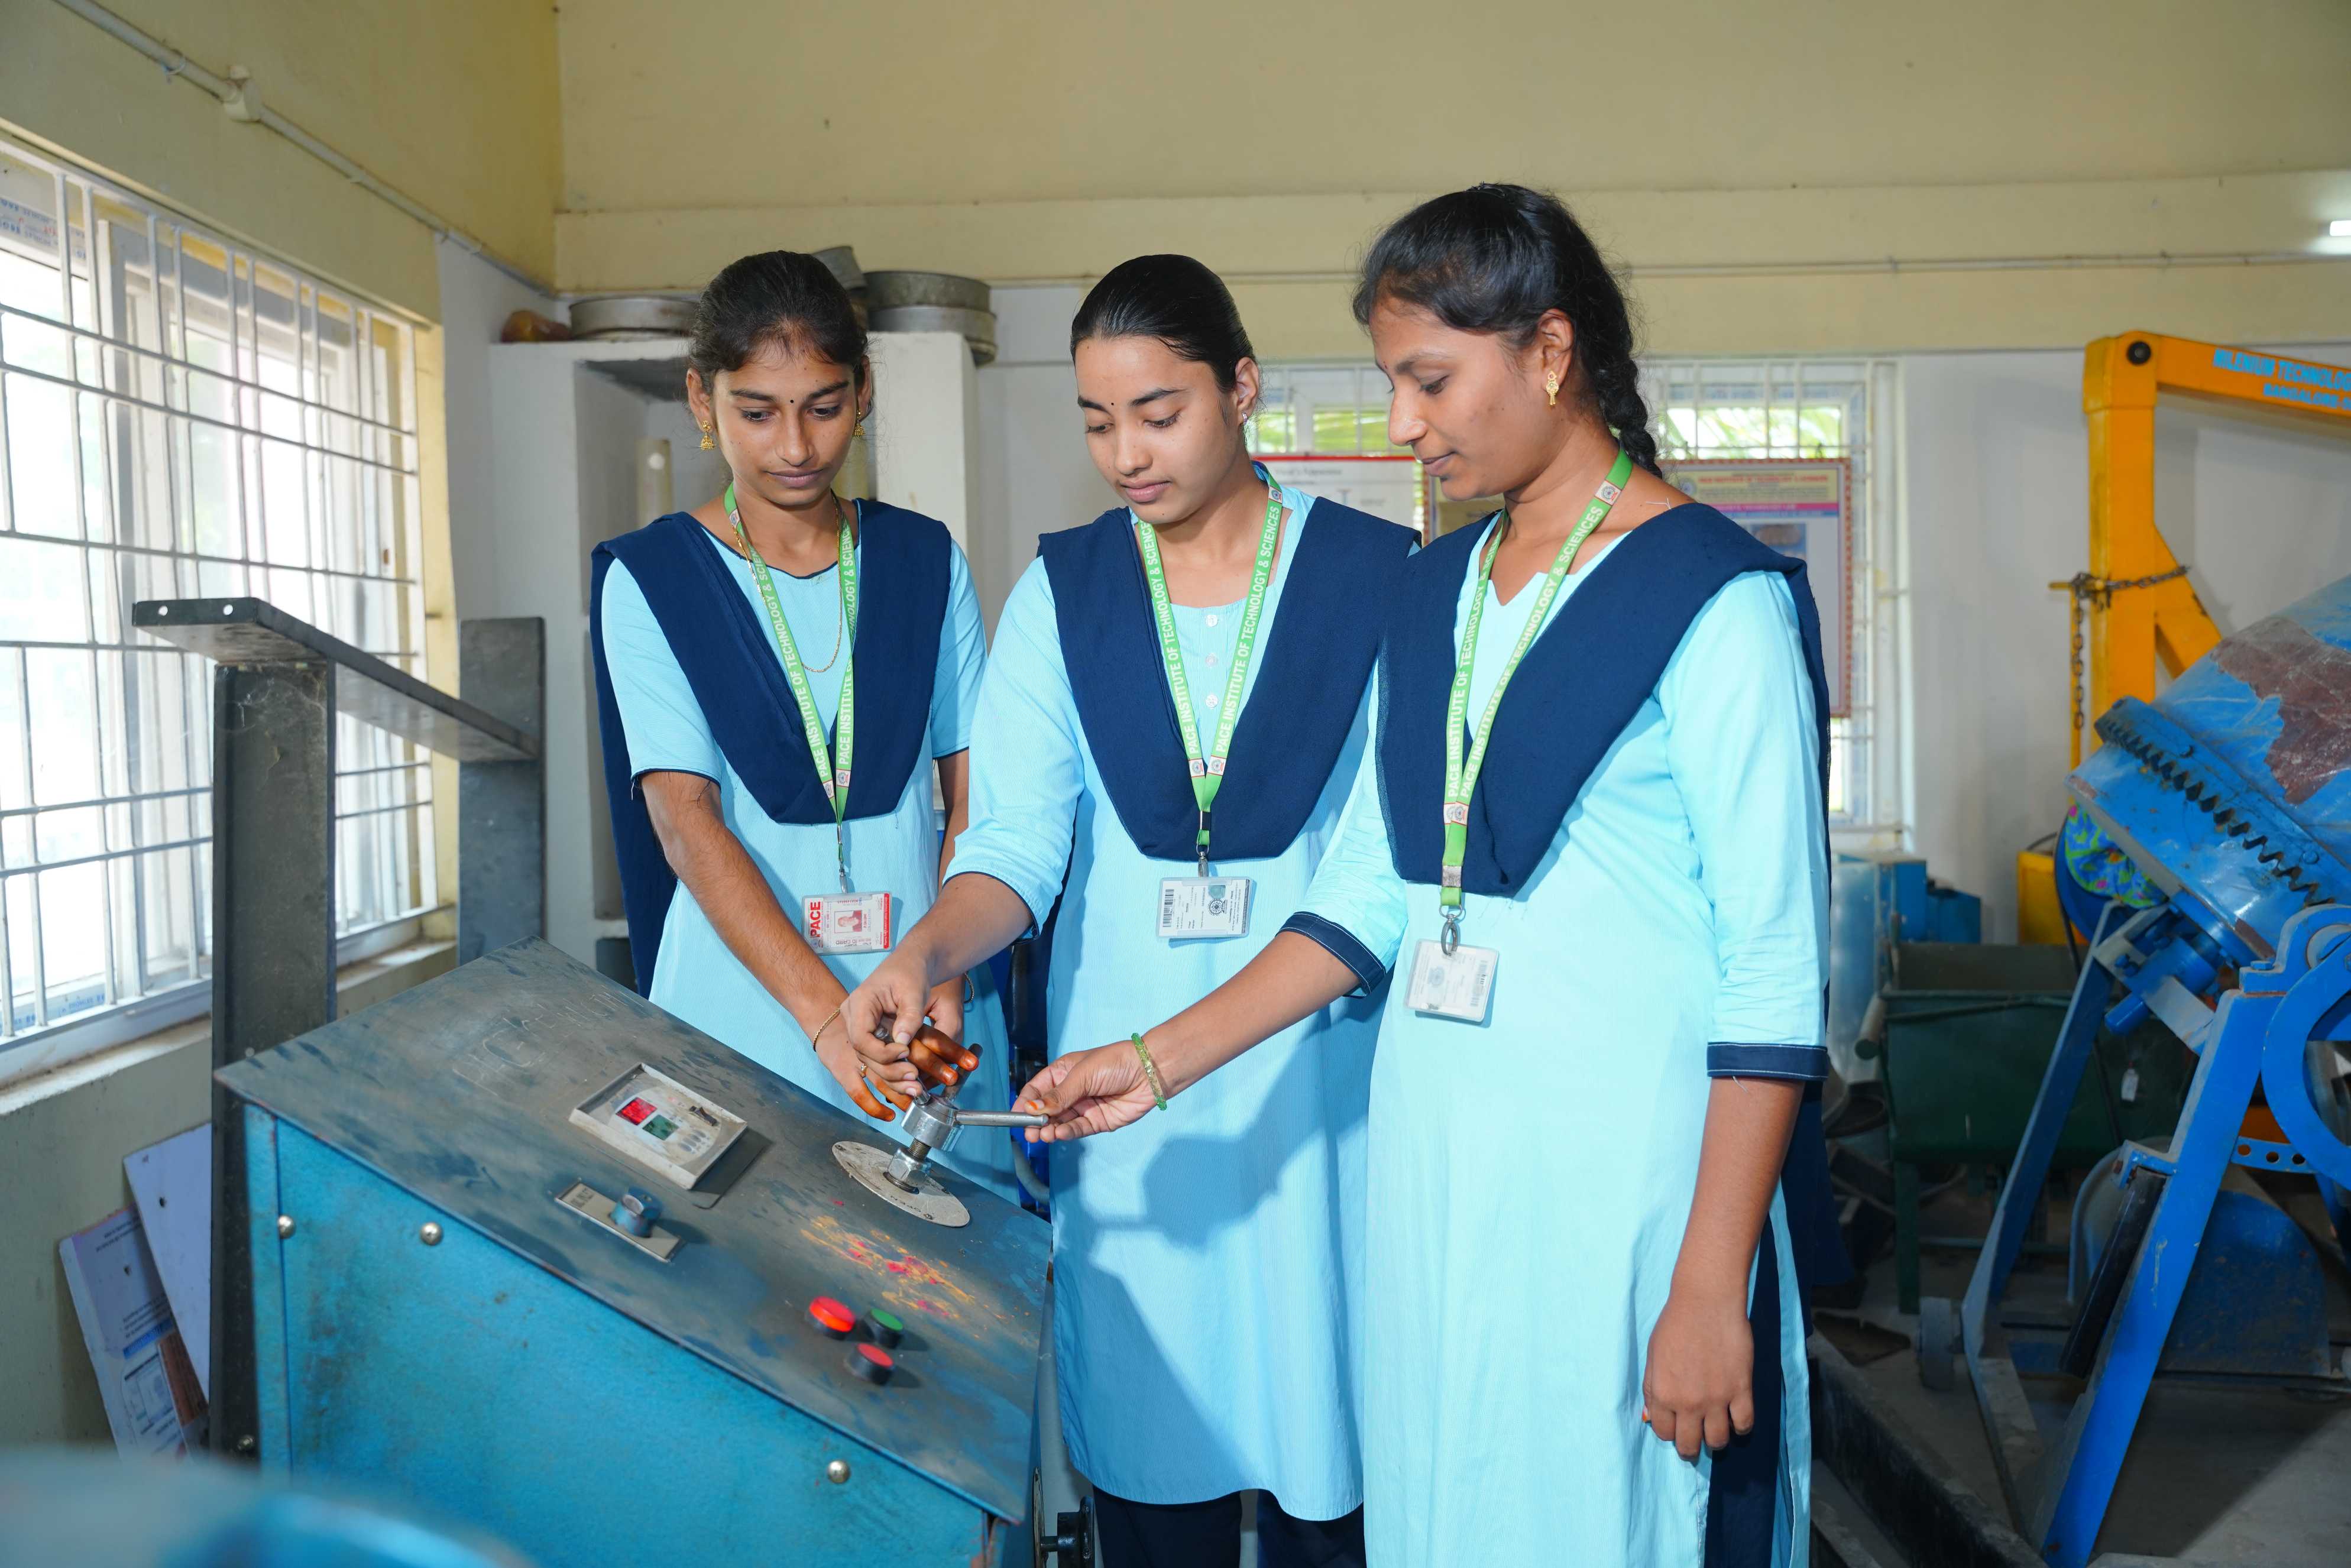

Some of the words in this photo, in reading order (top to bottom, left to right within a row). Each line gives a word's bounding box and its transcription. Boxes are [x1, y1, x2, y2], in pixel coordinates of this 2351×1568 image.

[1140, 520, 1158, 565] SCIENCE
[1261, 506, 1280, 558] SCIENCES
[1258, 559, 1268, 568] &
[1152, 577, 1176, 645] TECHNOLOGY
[1241, 570, 1267, 640] TECHNOLOGY
[1459, 585, 1487, 668] TECHNOLOGY
[766, 593, 797, 668] TECHNOLOGY
[1236, 642, 1249, 657] OF
[1461, 764, 1476, 797] PACE
[1471, 689, 1502, 762] INSTITUTE
[1500, 671, 1511, 685] OF
[1509, 578, 1559, 668] TECHNOLOGY
[1554, 568, 1565, 576] &
[1560, 506, 1604, 562] SCIENCES
[1167, 647, 1179, 660] OF
[791, 670, 802, 685] OF
[1170, 662, 1193, 723] INSTITUTE
[1223, 659, 1247, 720] INSTITUTE
[1456, 672, 1469, 686] OF
[796, 688, 821, 746] INSTITUTE
[840, 675, 852, 734] INSTITUTE
[1447, 689, 1465, 760] INSTITUTE
[839, 737, 851, 764] PACE
[1186, 725, 1199, 754] PACE
[1216, 723, 1231, 753] PACE
[815, 748, 828, 777] PACE
[1447, 763, 1459, 797] PACE
[810, 902, 821, 938] PACE
